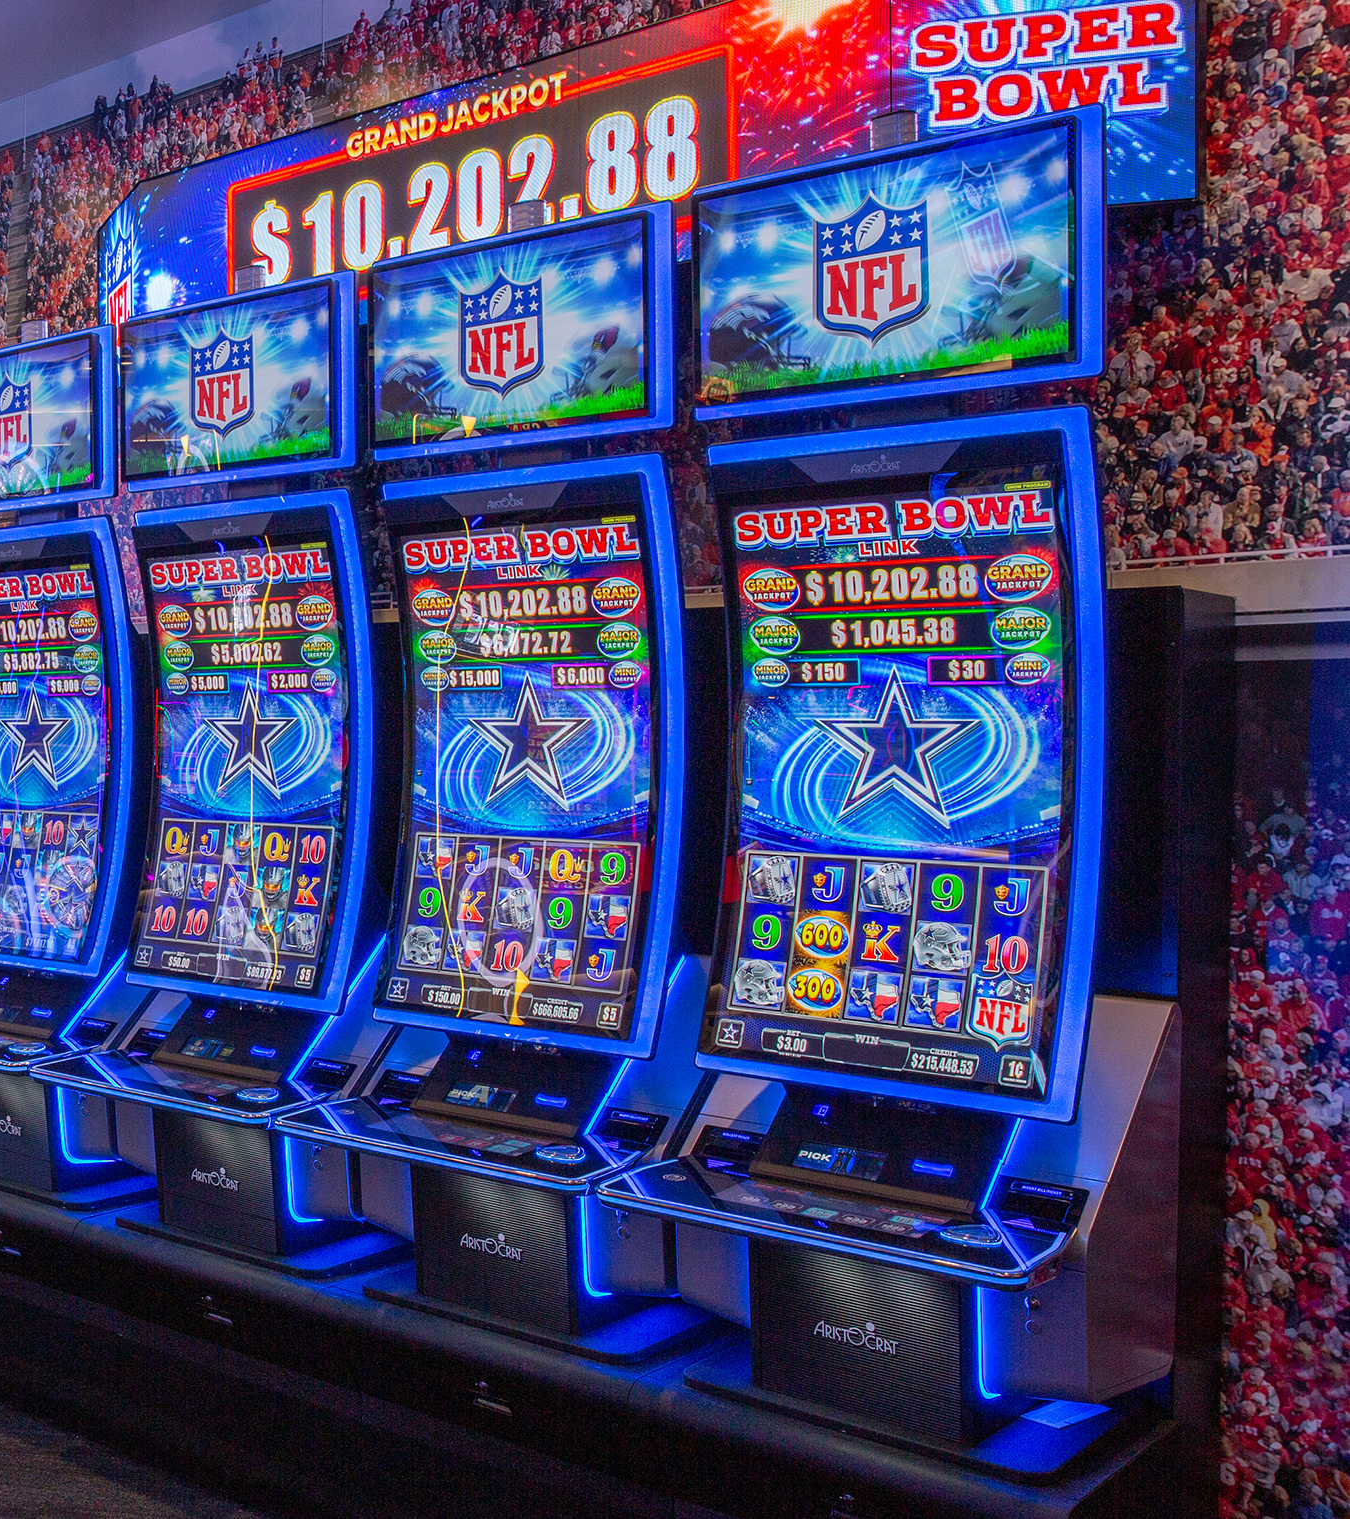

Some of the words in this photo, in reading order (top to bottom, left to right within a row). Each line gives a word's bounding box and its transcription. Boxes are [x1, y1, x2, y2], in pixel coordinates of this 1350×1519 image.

[914, 0, 1182, 72] SUPER
[931, 61, 1167, 130] BOWL
[346, 114, 437, 160] GRAND
[440, 70, 568, 133] JACKPOT
[826, 252, 918, 322] NFL
[466, 319, 535, 379] NFL
[195, 372, 249, 422] NFL
[735, 501, 891, 550] SUPER
[896, 491, 1054, 541] BOWL
[404, 535, 522, 574] SUPER
[524, 523, 641, 565] BOWL
[859, 539, 919, 558] LINK
[150, 556, 241, 593] SUPER
[242, 548, 332, 586] BOWL
[496, 563, 544, 580] LINK
[986, 563, 1051, 582] GRAND
[24, 569, 96, 601] BOWL
[593, 586, 639, 600] GRAND
[745, 575, 798, 594] GRAND
[805, 563, 979, 606] $10,202.88
[994, 579, 1042, 591] JACKPOT
[413, 597, 453, 611] GRAND
[458, 585, 588, 620] $10,202.88
[599, 598, 635, 608] JACKPOT
[753, 591, 793, 601] JACKPOT
[10, 600, 39, 612] LINK
[296, 602, 332, 616] GRAND
[419, 608, 450, 618] JACKPOT
[68, 617, 97, 629] GRAND
[159, 612, 190, 624] GRAND
[301, 613, 330, 623] JACKPOT
[994, 616, 1047, 633] MAJOR
[599, 631, 639, 644] MAJOR
[754, 624, 799, 640] MAJOR
[831, 616, 956, 648] $1,045.38
[1001, 629, 1041, 640] JACKPOT
[302, 642, 333, 654] MAJOR
[420, 637, 455, 650] MAJOR
[425, 646, 453, 655] JACKPOT
[603, 641, 636, 650] JACKPOT
[759, 636, 795, 647] JACKPOT
[74, 651, 99, 661] MAJOR
[166, 647, 192, 658] MAJOR
[3, 652, 60, 673] $5,882.75
[755, 664, 787, 676] MINOR
[947, 659, 986, 680] $30
[1012, 659, 1043, 671] MINI
[449, 669, 500, 687] $15,000
[557, 666, 605, 685] $6,000
[613, 667, 637, 677] MINI
[801, 662, 845, 682] $150
[1011, 669, 1045, 680] JACKPOT
[50, 679, 80, 693] $6,000
[191, 675, 225, 691] $5,000
[270, 673, 309, 690] $2,000
[43, 819, 65, 846] 10
[299, 834, 327, 865] 10
[599, 851, 628, 886] 9
[931, 873, 965, 912] 9
[417, 887, 441, 918] 9
[151, 904, 177, 933] 10
[183, 907, 208, 936] 10
[547, 897, 573, 930] 9
[751, 914, 782, 951] 9
[800, 922, 844, 950] 600
[861, 923, 901, 964] K
[167, 955, 191, 969] $50.00
[490, 938, 524, 973] 10
[984, 934, 1029, 975] 10
[299, 969, 312, 983] $5
[427, 988, 462, 1006] $150.00
[491, 987, 512, 997] WIN
[793, 973, 835, 1003] 300
[602, 1006, 618, 1023] $5
[976, 998, 1026, 1036] NFL
[776, 1035, 807, 1053] $3.00
[854, 1033, 881, 1046] WIN
[930, 1047, 959, 1058] CREDIT
[910, 1052, 975, 1076] $215,448.53
[451, 1088, 477, 1099] PICK
[799, 1150, 832, 1163] PICK
[190, 1166, 240, 1192] ARISTOCRAT
[460, 1233, 523, 1262] ARISTOCRAT
[813, 1321, 899, 1356] ARISTOCRAT
